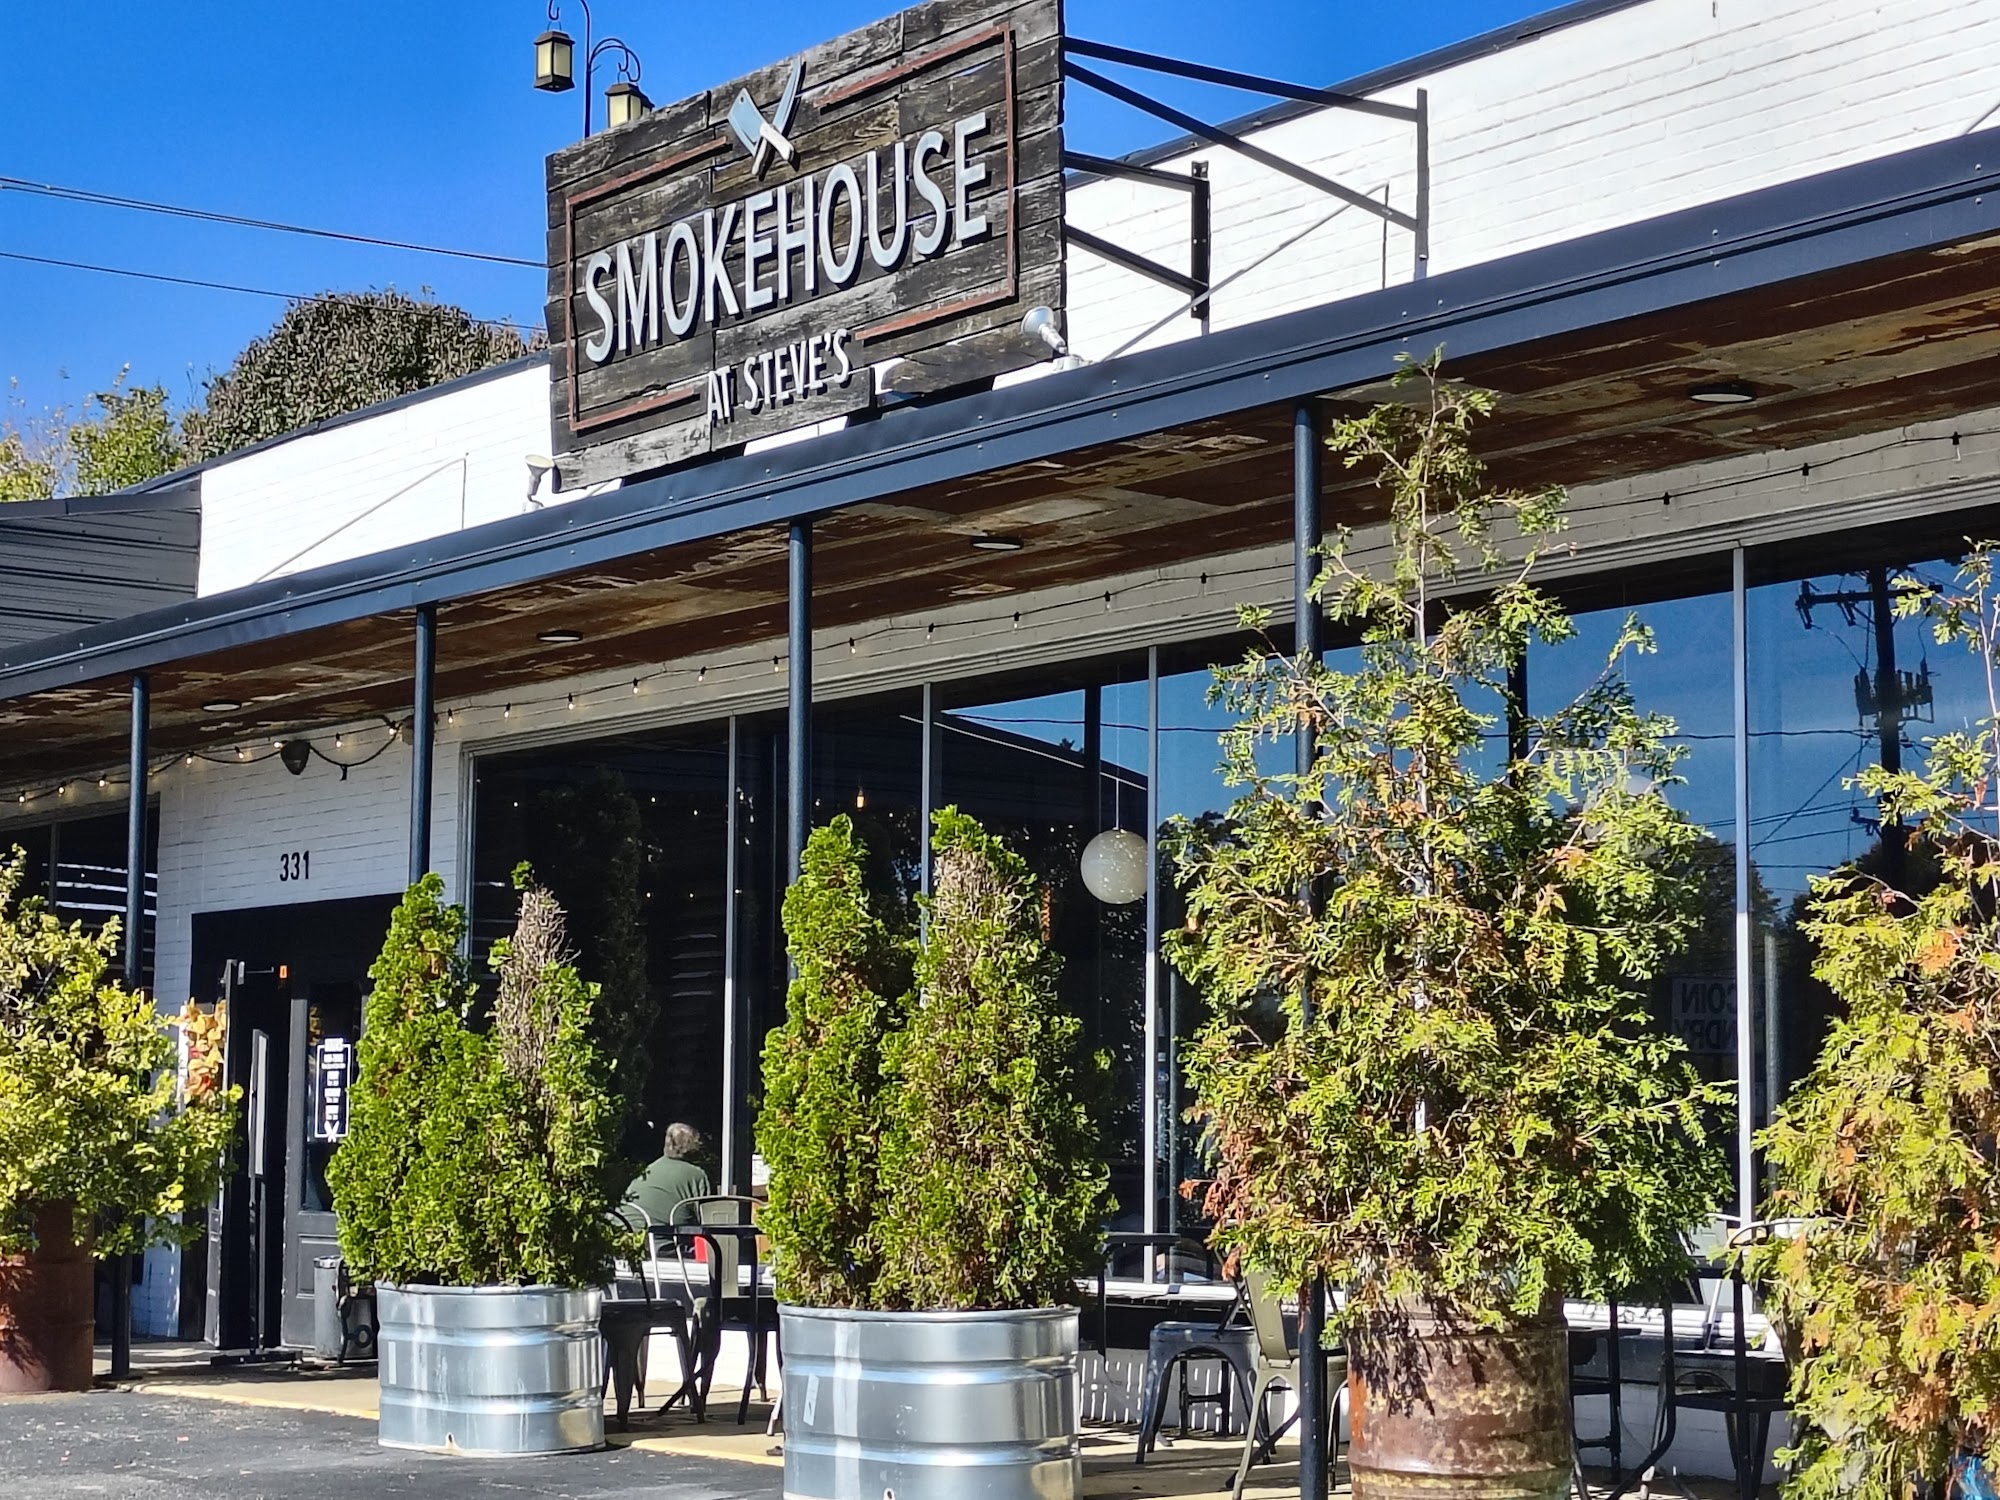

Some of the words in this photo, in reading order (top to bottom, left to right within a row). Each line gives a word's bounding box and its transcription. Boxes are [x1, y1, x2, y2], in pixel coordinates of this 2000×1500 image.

[585, 112, 987, 363] SMOKEHOUSE
[707, 365, 731, 421] AT
[743, 328, 849, 410] STEVE'S
[279, 850, 310, 882] 331
